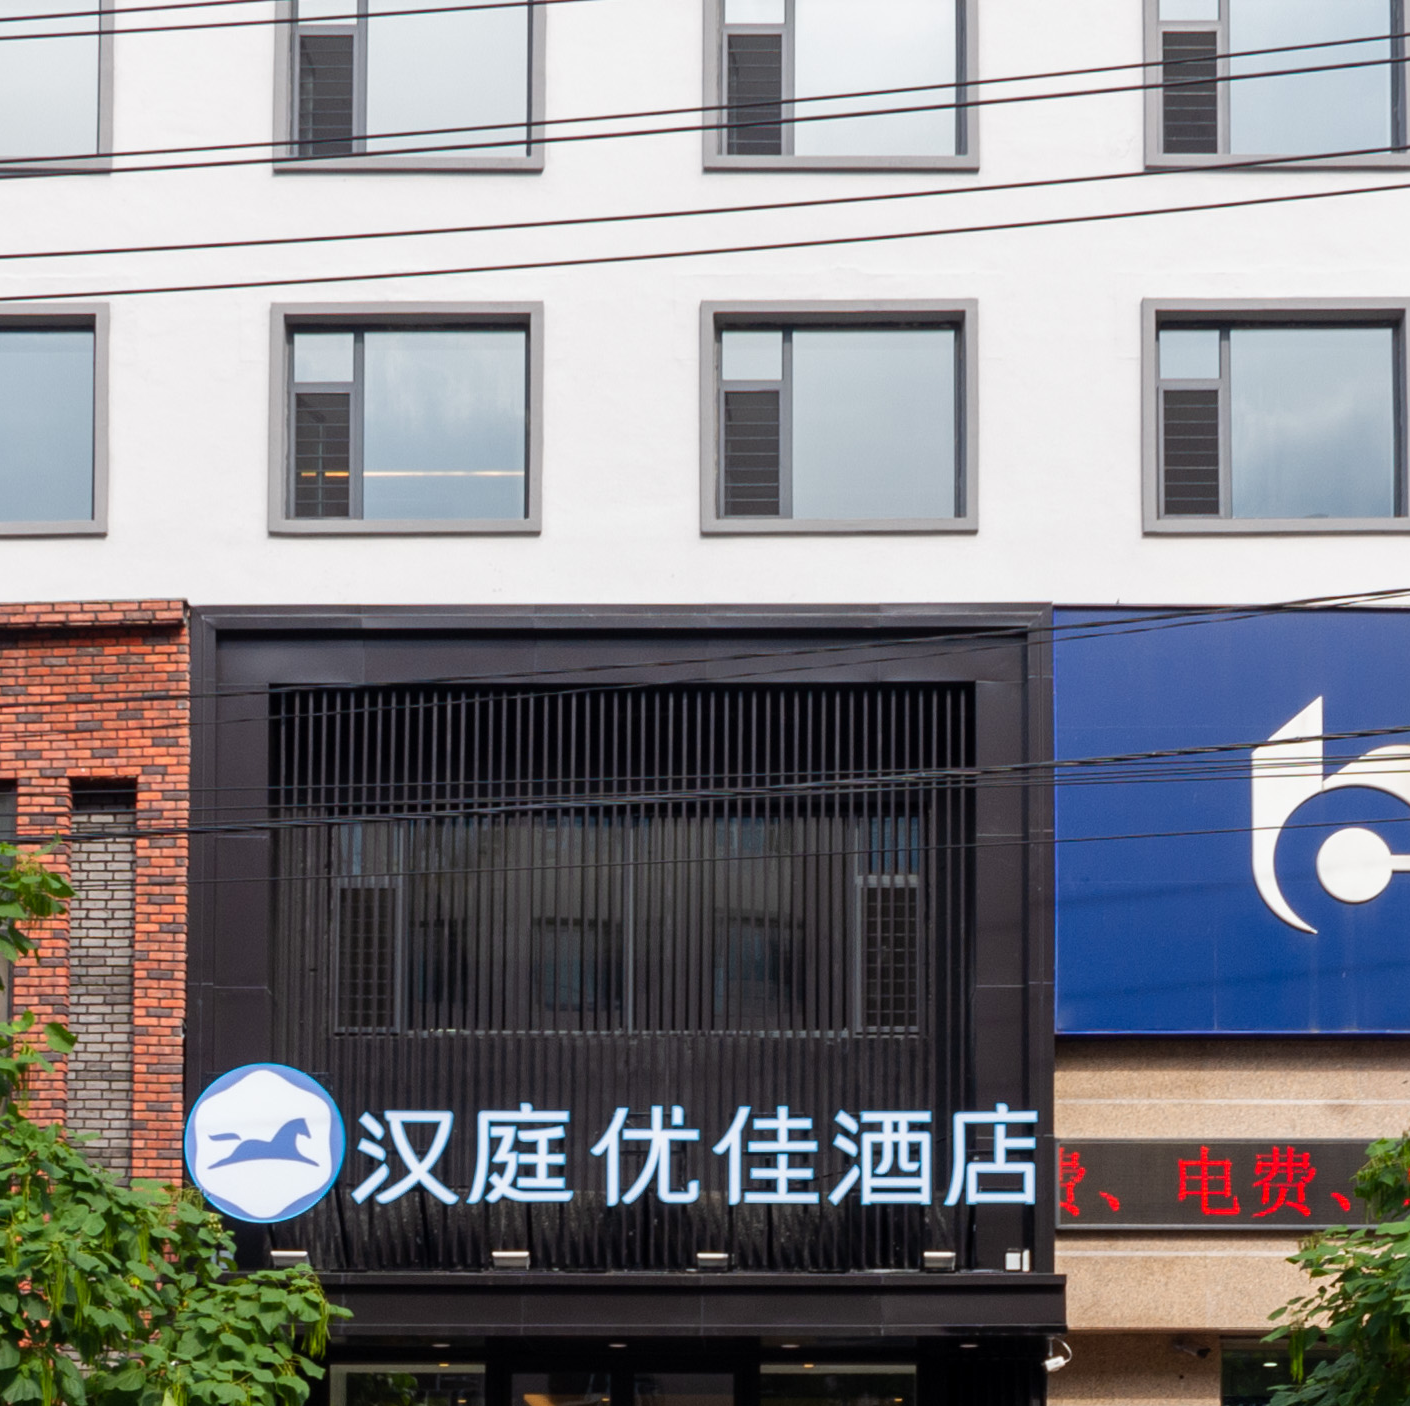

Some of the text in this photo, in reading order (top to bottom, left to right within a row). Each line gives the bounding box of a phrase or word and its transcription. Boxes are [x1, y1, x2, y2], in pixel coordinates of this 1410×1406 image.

[351, 1102, 1039, 1206] 汉庭优佳酒店
